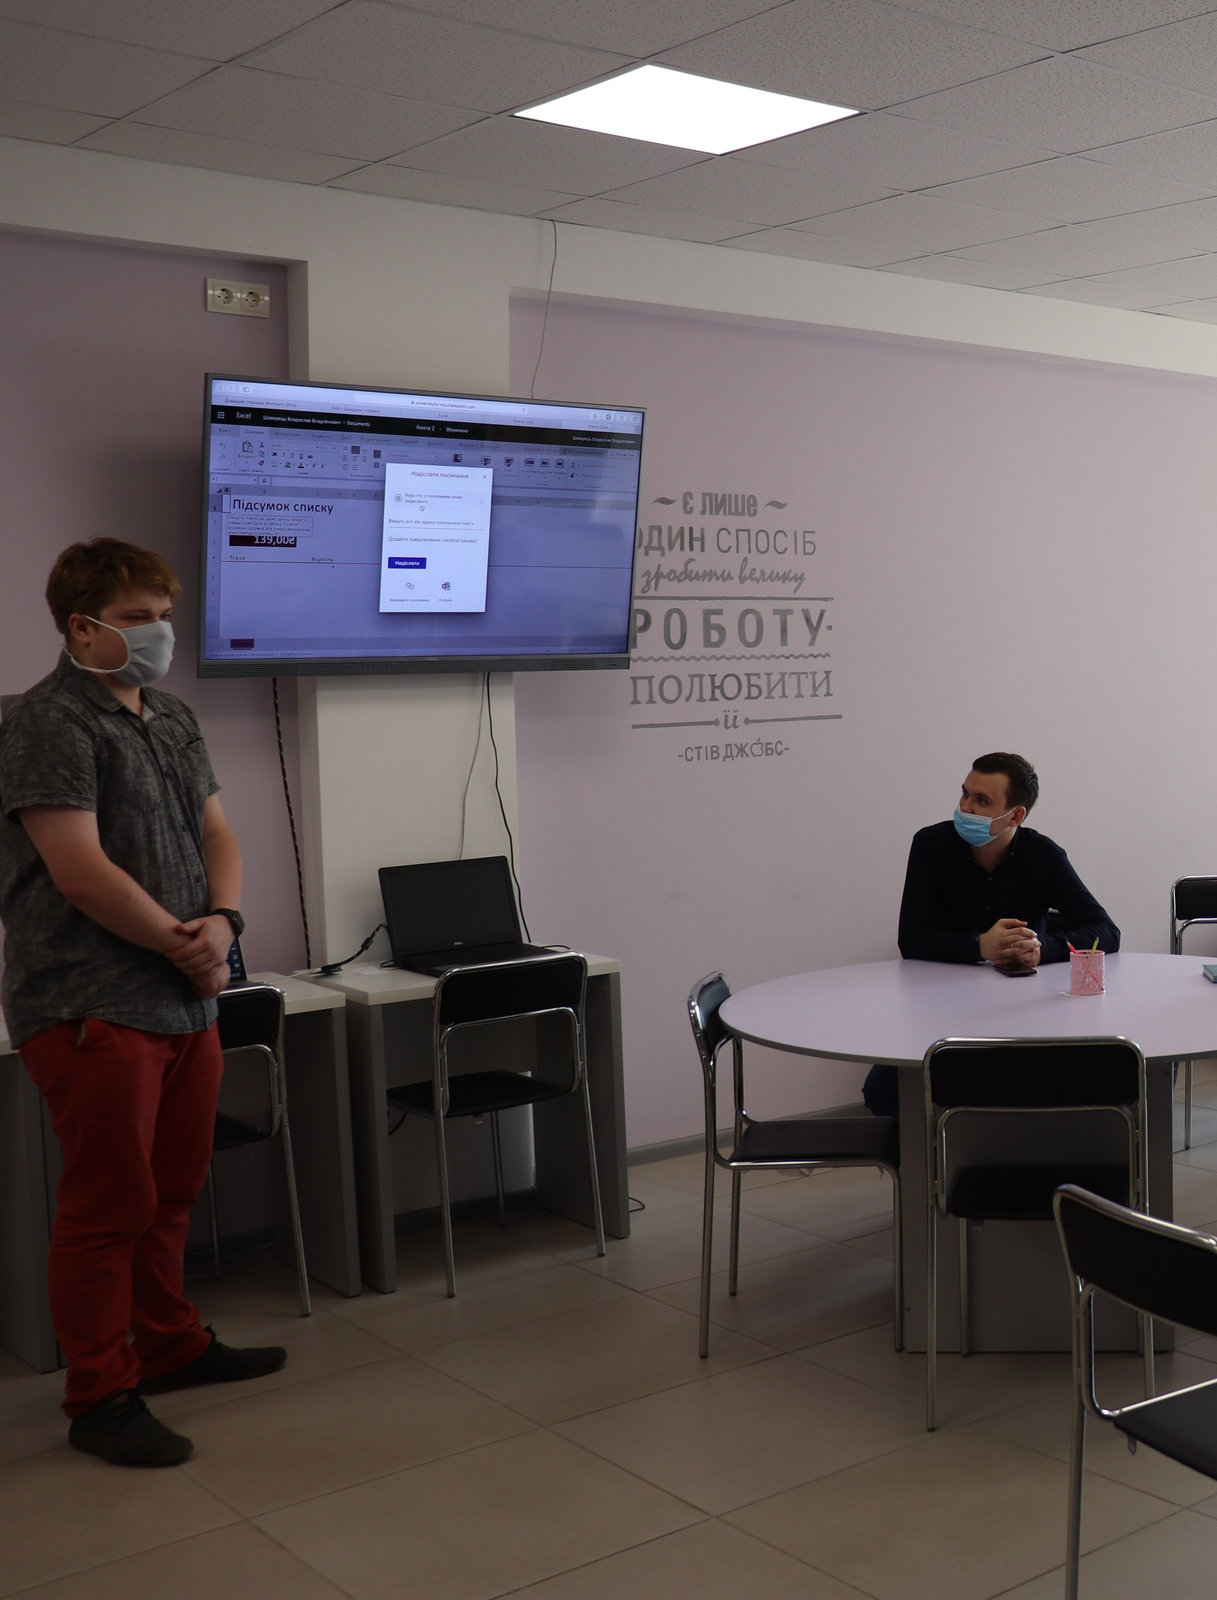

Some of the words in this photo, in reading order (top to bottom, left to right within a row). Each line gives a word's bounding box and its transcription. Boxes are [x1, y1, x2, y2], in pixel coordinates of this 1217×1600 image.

[236, 411, 252, 419] Excel
[233, 499, 290, 513] Підсумок
[293, 503, 334, 515] списку
[716, 528, 816, 555] СПОСІБ
[641, 558, 734, 594] зробити
[738, 557, 806, 593] велику
[630, 670, 833, 705] ПОЛЮБИТИ
